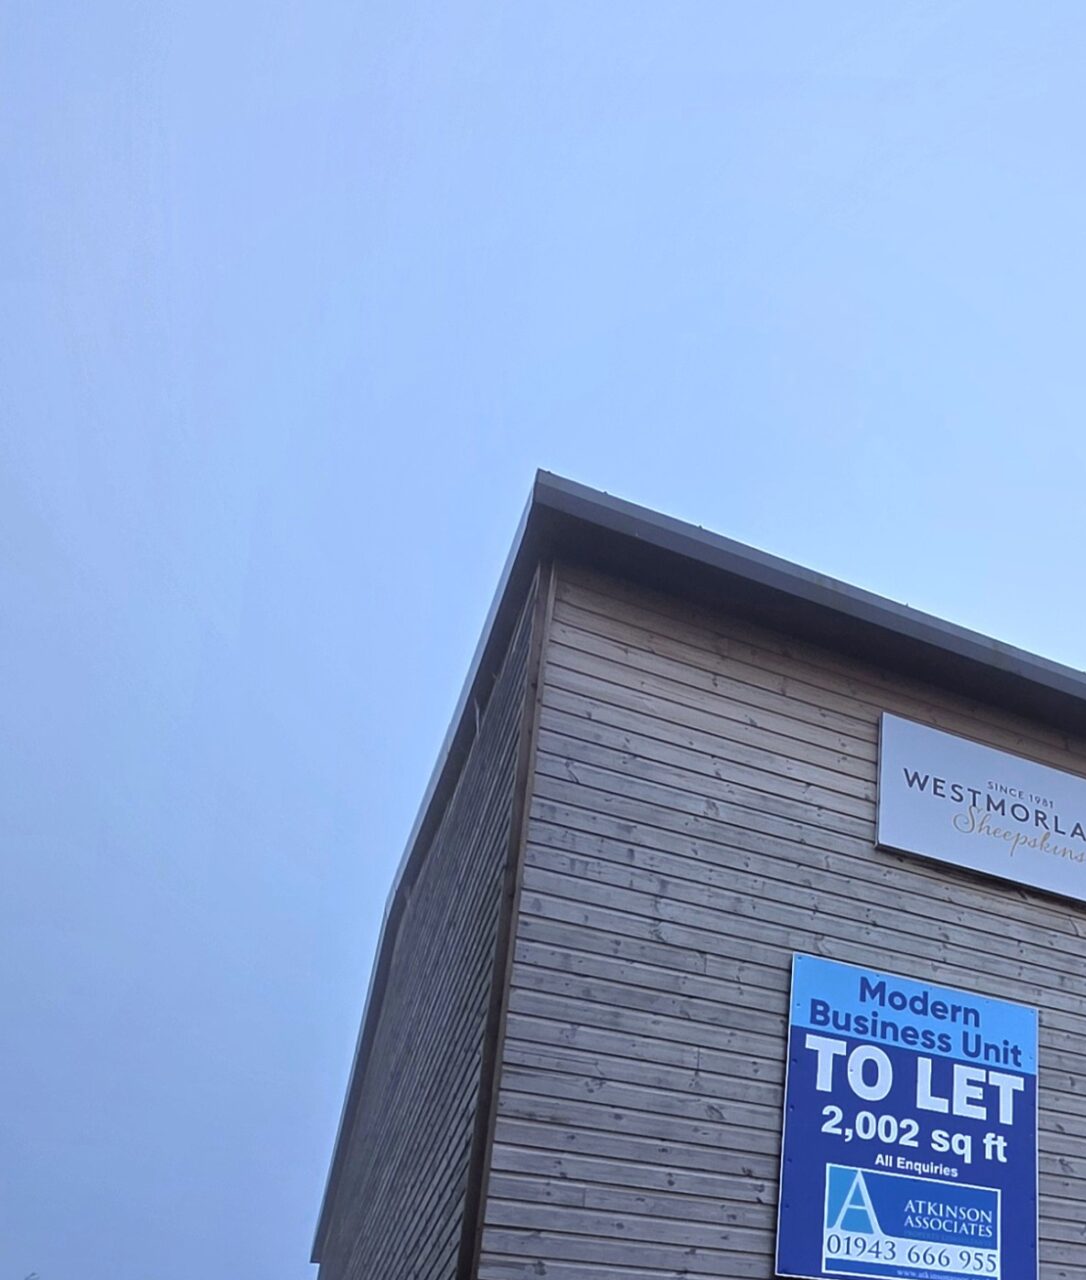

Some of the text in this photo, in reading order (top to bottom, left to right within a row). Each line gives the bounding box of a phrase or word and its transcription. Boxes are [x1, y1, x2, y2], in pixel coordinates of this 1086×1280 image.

[987, 781, 1024, 800] SINCE
[952, 805, 1086, 863] Sheepskins
[858, 976, 980, 1028] Modern
[809, 998, 1022, 1067] Business Unit
[805, 1033, 1025, 1126] TO LET
[821, 1104, 1008, 1164] 2,002 sq ft
[875, 1153, 958, 1178] All Enquiries
[904, 1199, 993, 1223] ATKINSON
[904, 1215, 993, 1238] ASSOCIATES
[826, 1233, 896, 1260] 01943
[907, 1244, 950, 1267] 666
[959, 1250, 997, 1273] 955
